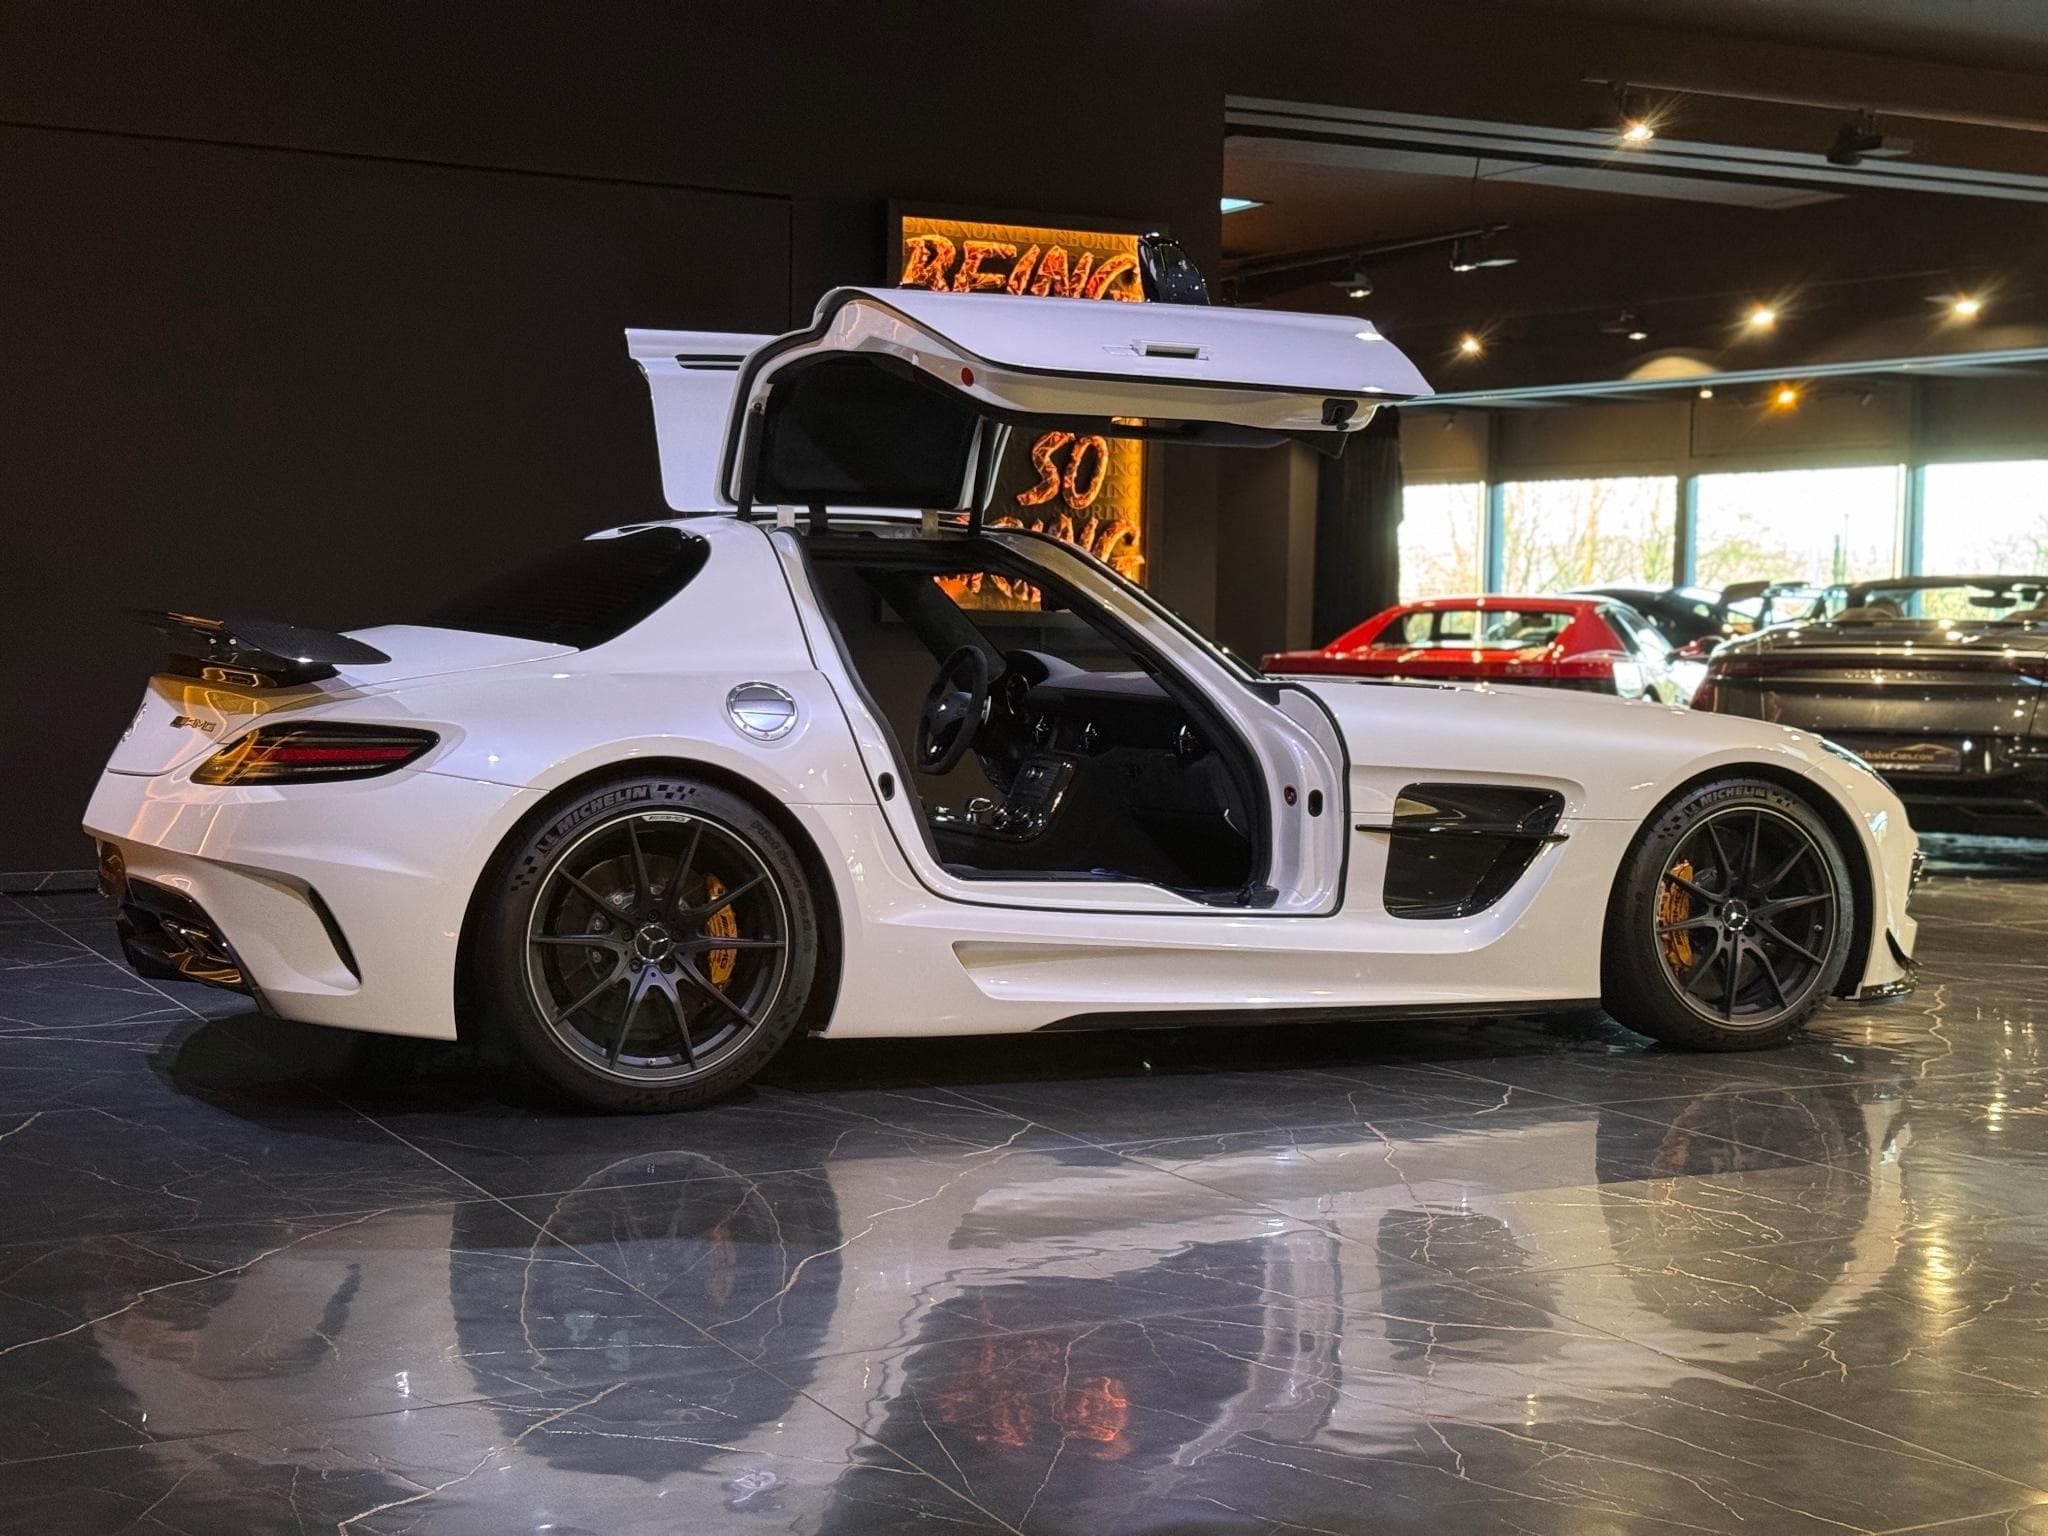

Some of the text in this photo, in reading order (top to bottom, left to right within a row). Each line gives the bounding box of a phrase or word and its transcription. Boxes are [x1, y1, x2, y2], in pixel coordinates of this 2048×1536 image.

[1016, 430, 1109, 510] SO
[556, 785, 649, 835] MICHELIN
[1699, 787, 1766, 806] MICHELIN
